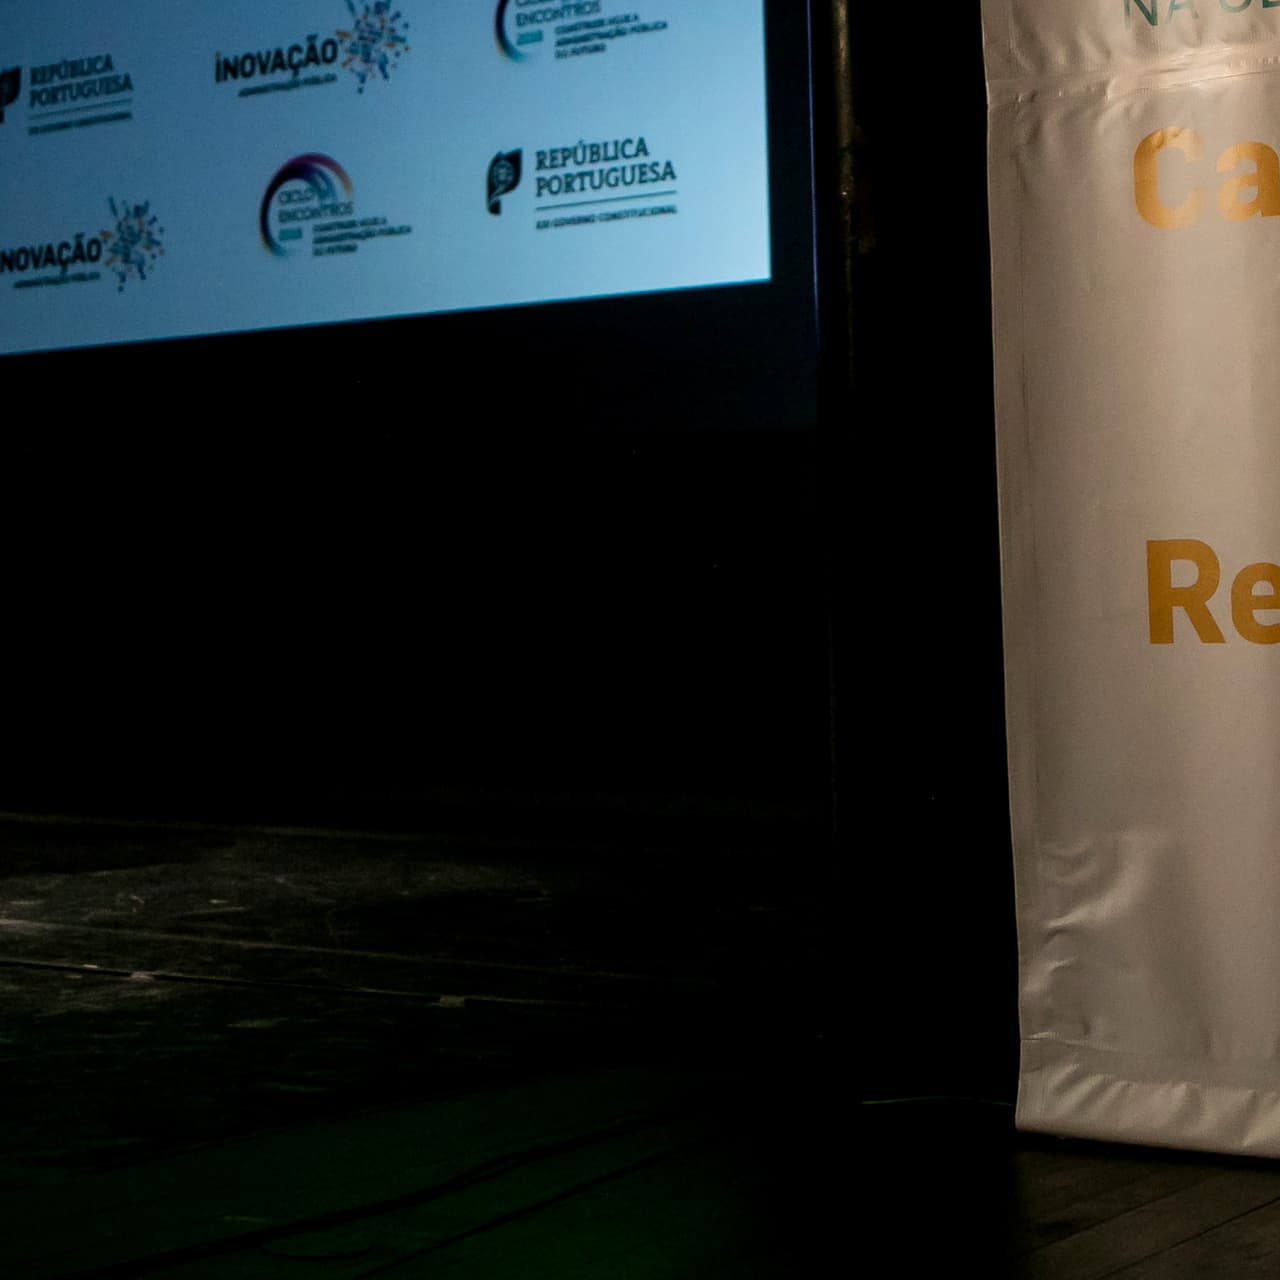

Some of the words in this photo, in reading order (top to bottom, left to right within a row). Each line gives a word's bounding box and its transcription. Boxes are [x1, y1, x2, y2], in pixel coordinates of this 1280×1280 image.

[30, 72, 134, 109] PORTUGUESA
[535, 136, 650, 172] REPÚBLICA
[535, 160, 677, 198] PORTUGUESA
